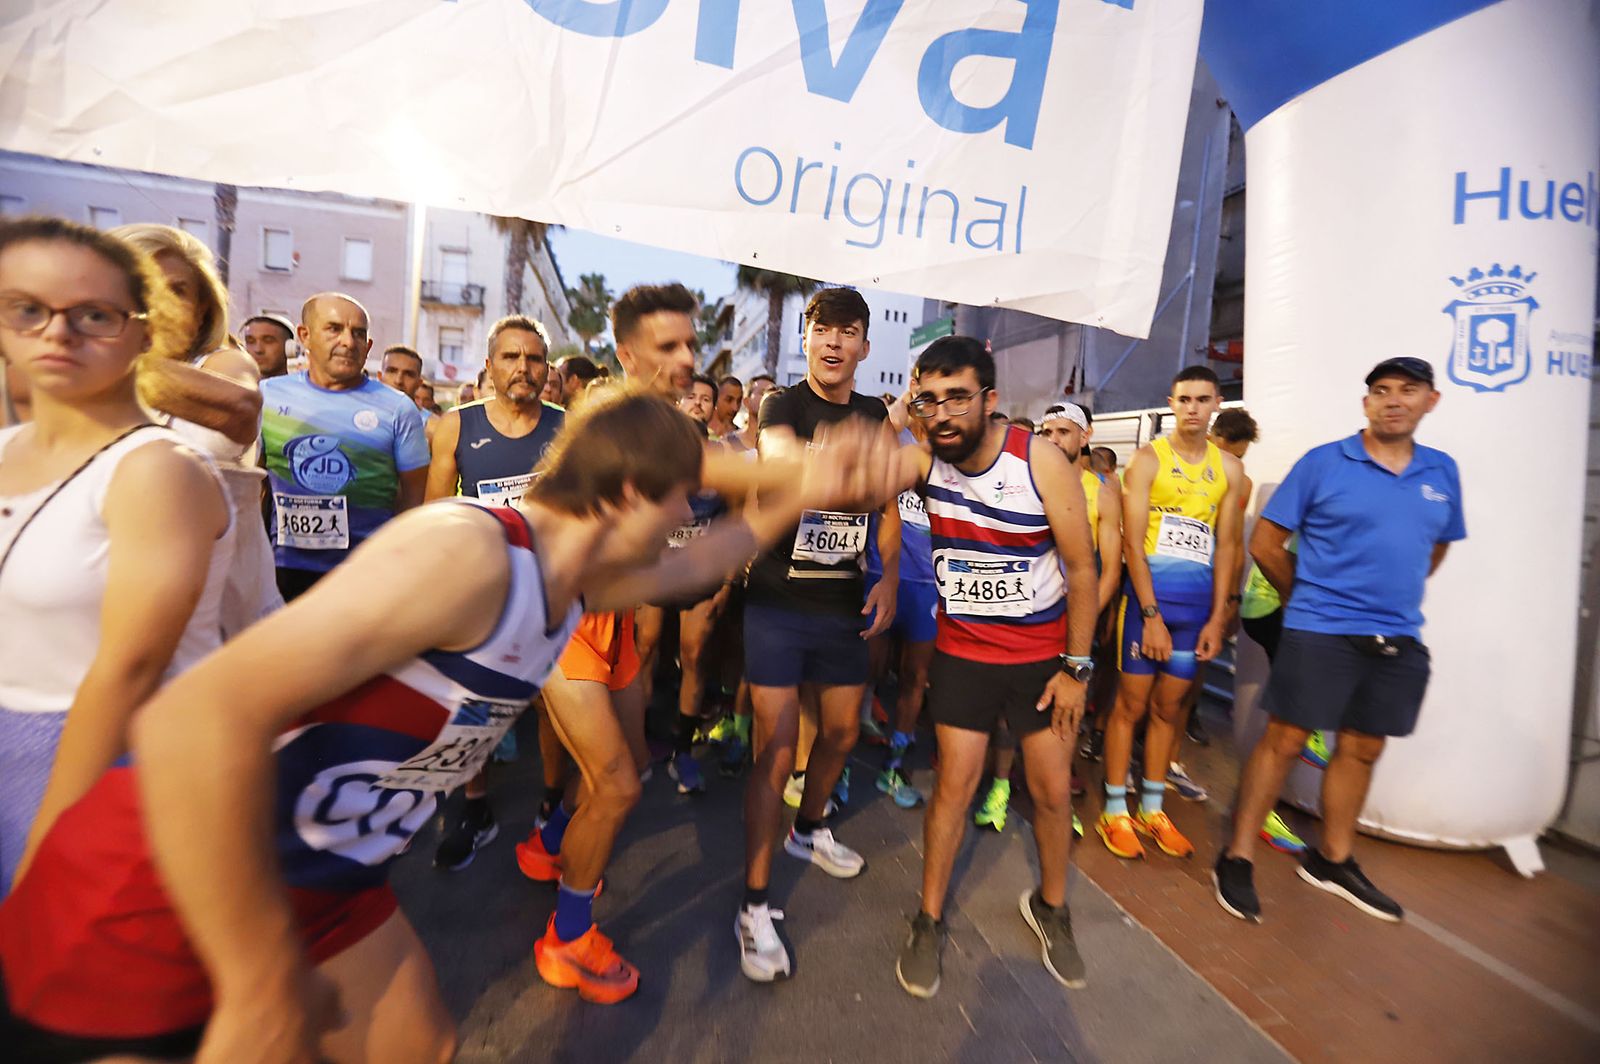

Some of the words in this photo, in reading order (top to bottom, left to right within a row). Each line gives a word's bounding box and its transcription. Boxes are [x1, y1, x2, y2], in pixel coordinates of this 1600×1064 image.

[733, 142, 1028, 255] original
[1453, 166, 1597, 226] Huel
[313, 457, 343, 474] JD
[290, 514, 325, 534] 682
[816, 531, 848, 550] 604
[968, 579, 1007, 600] 486
